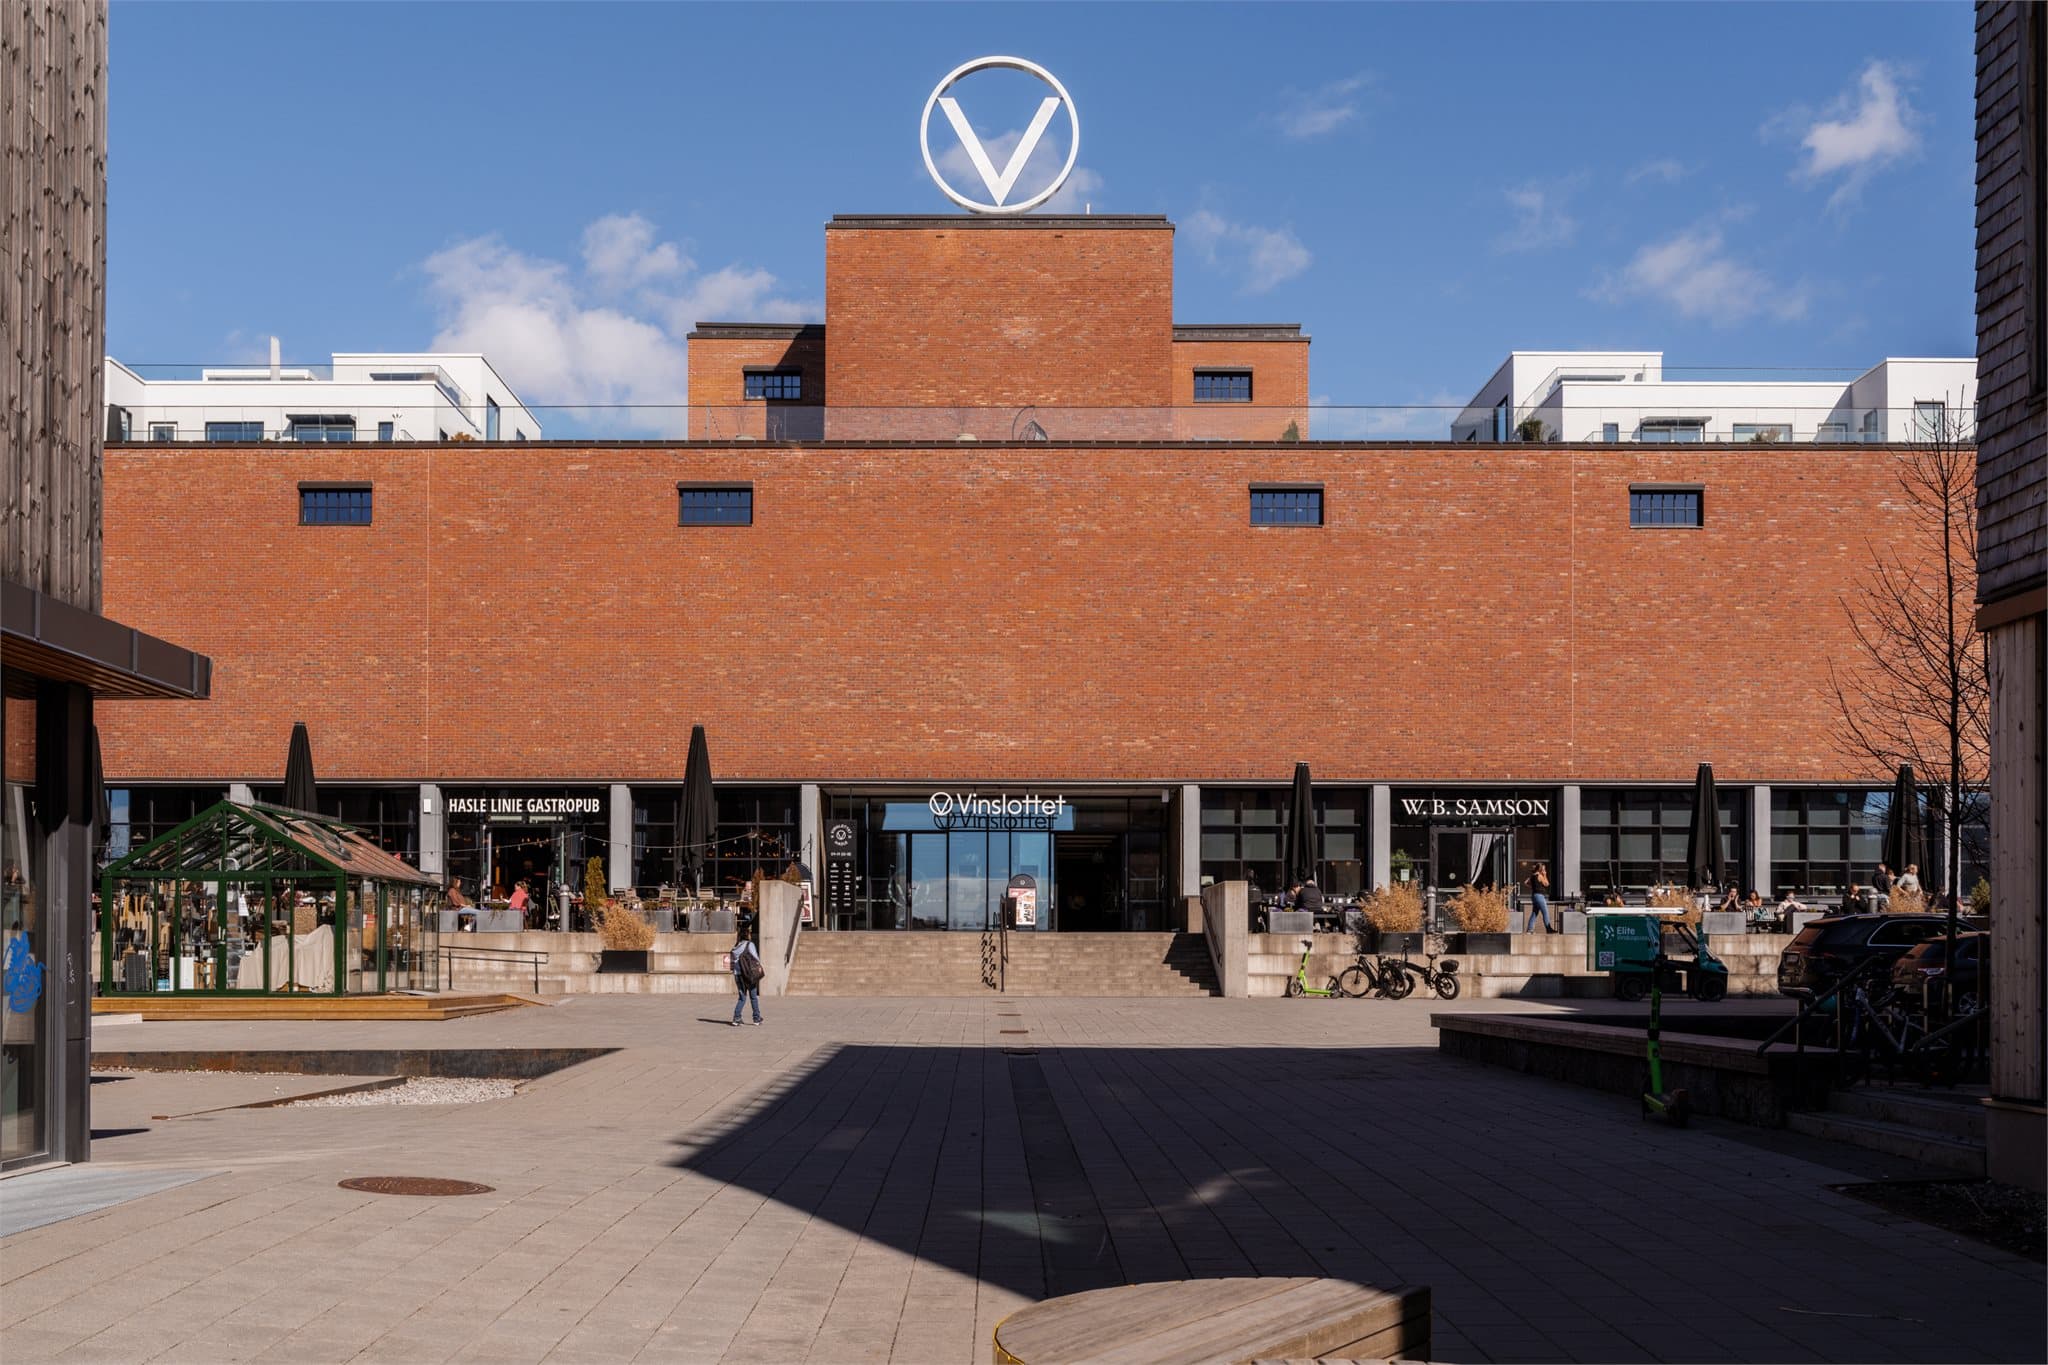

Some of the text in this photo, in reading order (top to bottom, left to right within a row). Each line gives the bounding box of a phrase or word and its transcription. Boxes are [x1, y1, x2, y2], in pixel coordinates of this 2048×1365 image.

[937, 97, 1061, 207] V
[449, 798, 600, 813] HASLE LINIE GASTROPUB
[957, 793, 1067, 815] Vinslottet
[1401, 799, 1550, 816] W. B. SAMSON
